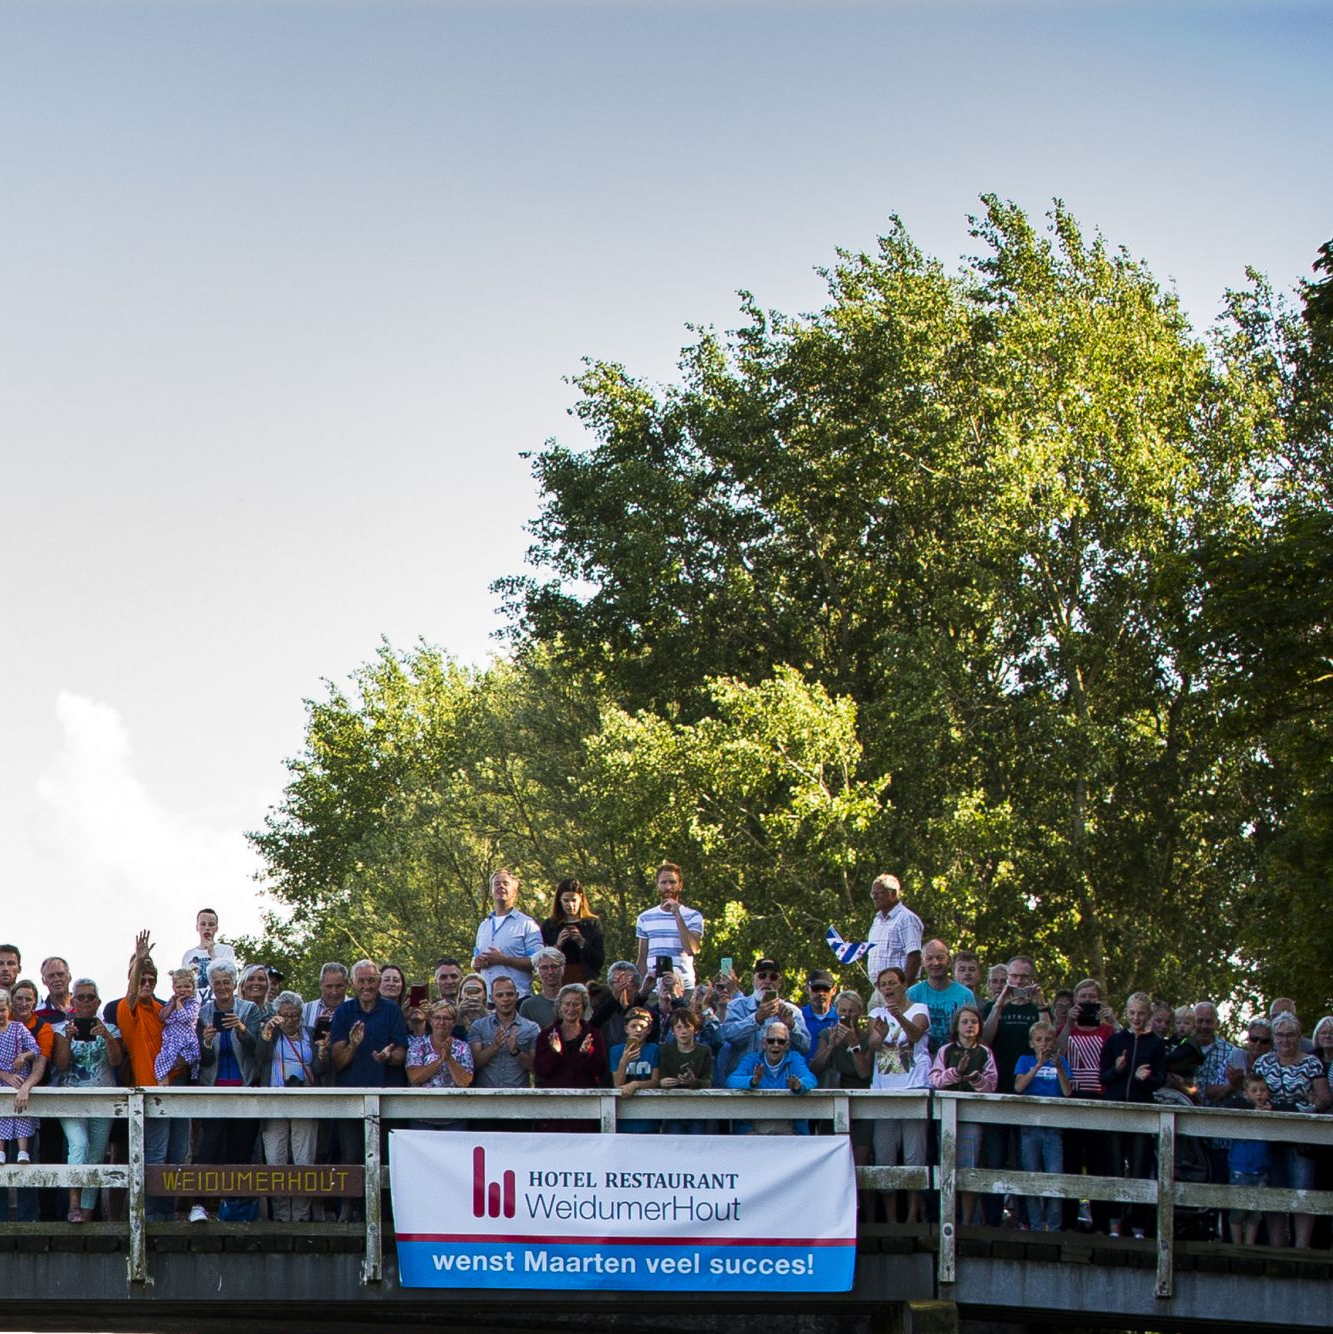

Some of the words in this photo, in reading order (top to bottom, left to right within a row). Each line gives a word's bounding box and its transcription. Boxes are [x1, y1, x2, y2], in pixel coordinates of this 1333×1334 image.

[162, 1171, 349, 1191] WEIDUMERHOUT
[529, 1171, 597, 1187] HOTEL
[605, 1172, 739, 1189] RESTAURANT
[525, 1193, 741, 1221] WeidumerHout
[432, 1252, 514, 1272] wenst
[524, 1251, 636, 1274] Maarten
[646, 1253, 700, 1274] veel
[709, 1254, 814, 1275] succes!
